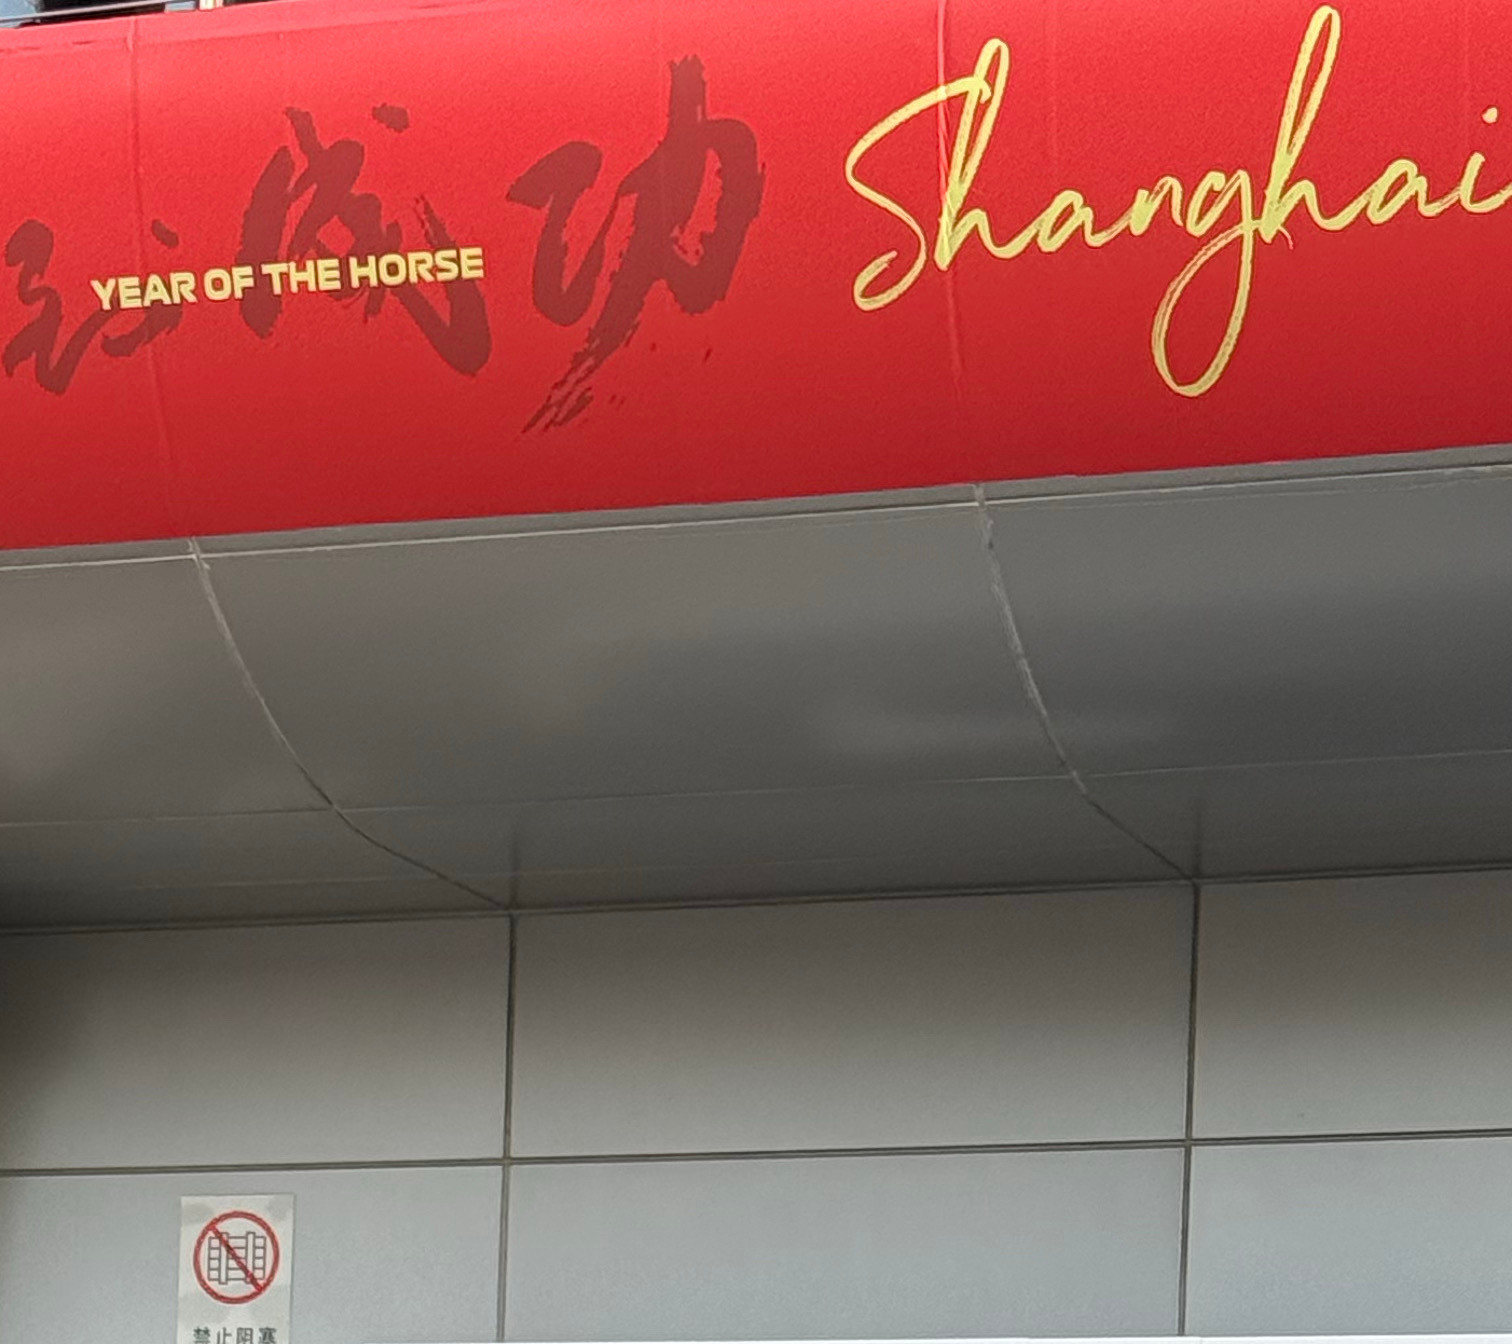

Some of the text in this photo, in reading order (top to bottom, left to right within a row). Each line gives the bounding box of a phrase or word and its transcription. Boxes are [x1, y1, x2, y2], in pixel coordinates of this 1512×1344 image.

[90, 247, 485, 311] YEAR OF THE HORSE
[844, 4, 1512, 397] Shanghai
